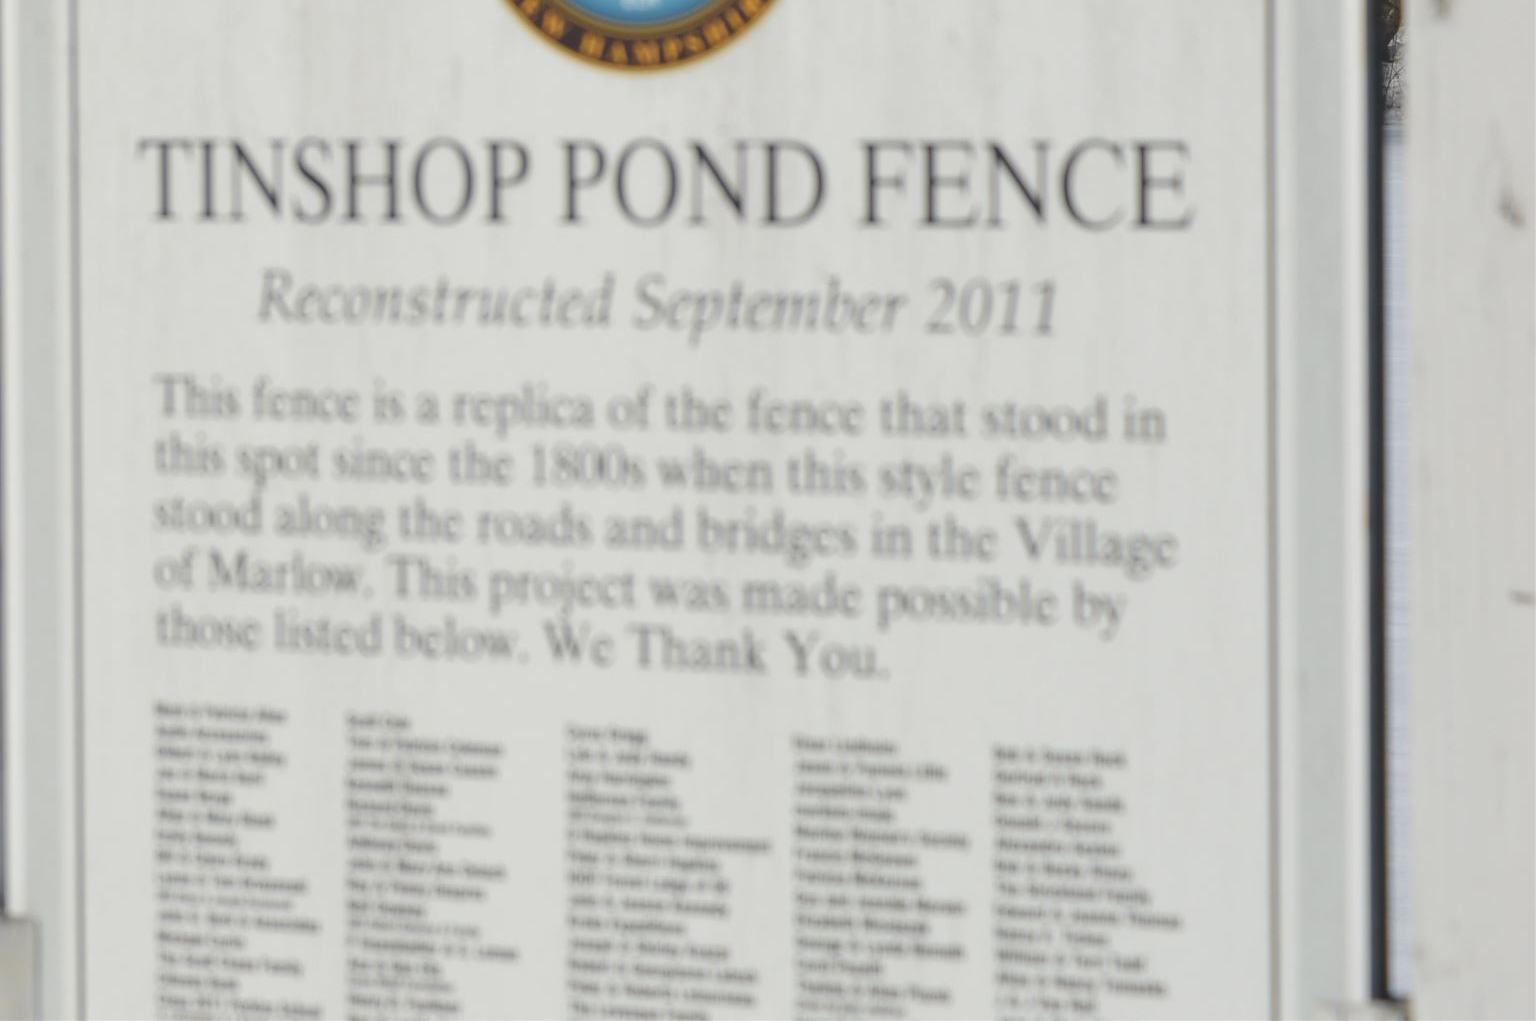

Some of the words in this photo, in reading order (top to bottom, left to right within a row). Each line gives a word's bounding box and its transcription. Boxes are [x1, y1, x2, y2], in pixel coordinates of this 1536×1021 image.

[137, 135, 531, 226] TINSHOP
[560, 136, 828, 228] POND
[857, 137, 1194, 231] FENCE
[260, 267, 616, 331] Reconstructed
[631, 272, 907, 346] September
[923, 279, 1057, 338] 2011
[156, 373, 239, 420] This
[252, 375, 358, 423] fence
[373, 377, 404, 423] is
[416, 391, 439, 424] a
[453, 382, 594, 439] replica
[607, 382, 653, 430] of
[665, 387, 732, 433] the
[747, 386, 863, 435] fence
[879, 390, 966, 438] that
[981, 393, 1108, 442] stood
[1123, 393, 1167, 442] in
[155, 431, 225, 475] this
[236, 442, 319, 490] spot
[333, 436, 433, 481] since
[449, 440, 513, 485] the
[531, 442, 645, 488] 1800s
[656, 447, 773, 493] when
[787, 448, 866, 496] this
[878, 452, 980, 511] style
[995, 452, 1118, 504] fence
[154, 491, 263, 534] stood
[274, 493, 386, 551] along
[398, 496, 462, 542] the
[478, 500, 592, 548] roads
[604, 505, 684, 551] and
[697, 506, 858, 568] bridges
[871, 510, 913, 560] in
[928, 513, 998, 561] the
[1014, 516, 1179, 581] Village
[154, 546, 197, 591] of
[208, 550, 373, 598] Marlow.
[386, 553, 477, 602] This
[490, 560, 635, 618] project
[650, 578, 730, 613] was
[742, 572, 862, 618] made
[877, 577, 1058, 633] possible
[1073, 581, 1127, 642] by
[155, 603, 262, 650] those
[274, 607, 382, 656] listed
[394, 613, 529, 664] below.
[542, 620, 614, 668] We
[625, 622, 766, 674] Thank
[784, 629, 890, 681] You.
